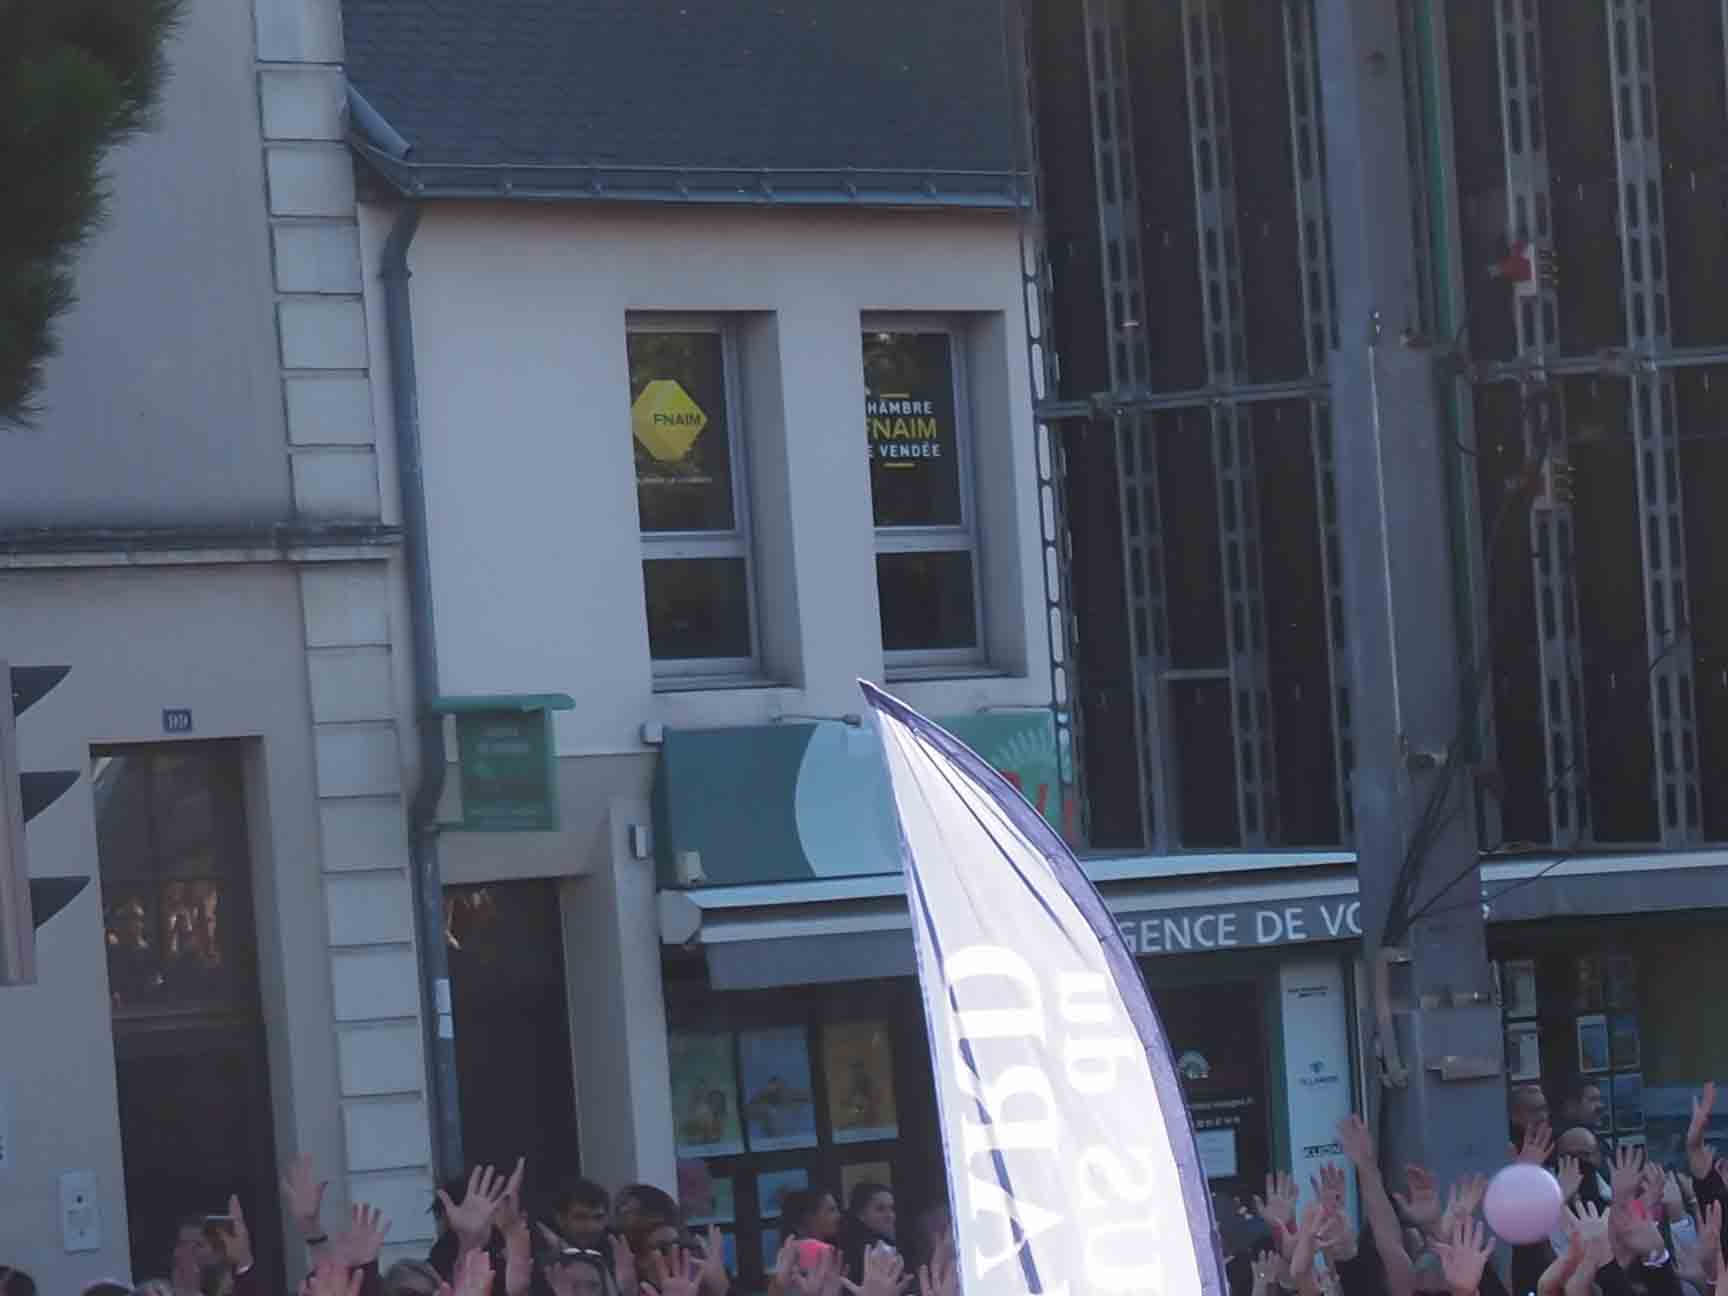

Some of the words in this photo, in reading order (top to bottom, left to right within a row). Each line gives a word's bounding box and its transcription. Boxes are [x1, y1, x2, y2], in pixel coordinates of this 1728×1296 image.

[866, 401, 933, 415] HAMBRE
[654, 413, 702, 426] FNAIM
[880, 444, 942, 458] VENDÉE
[1257, 907, 1307, 944] DE
